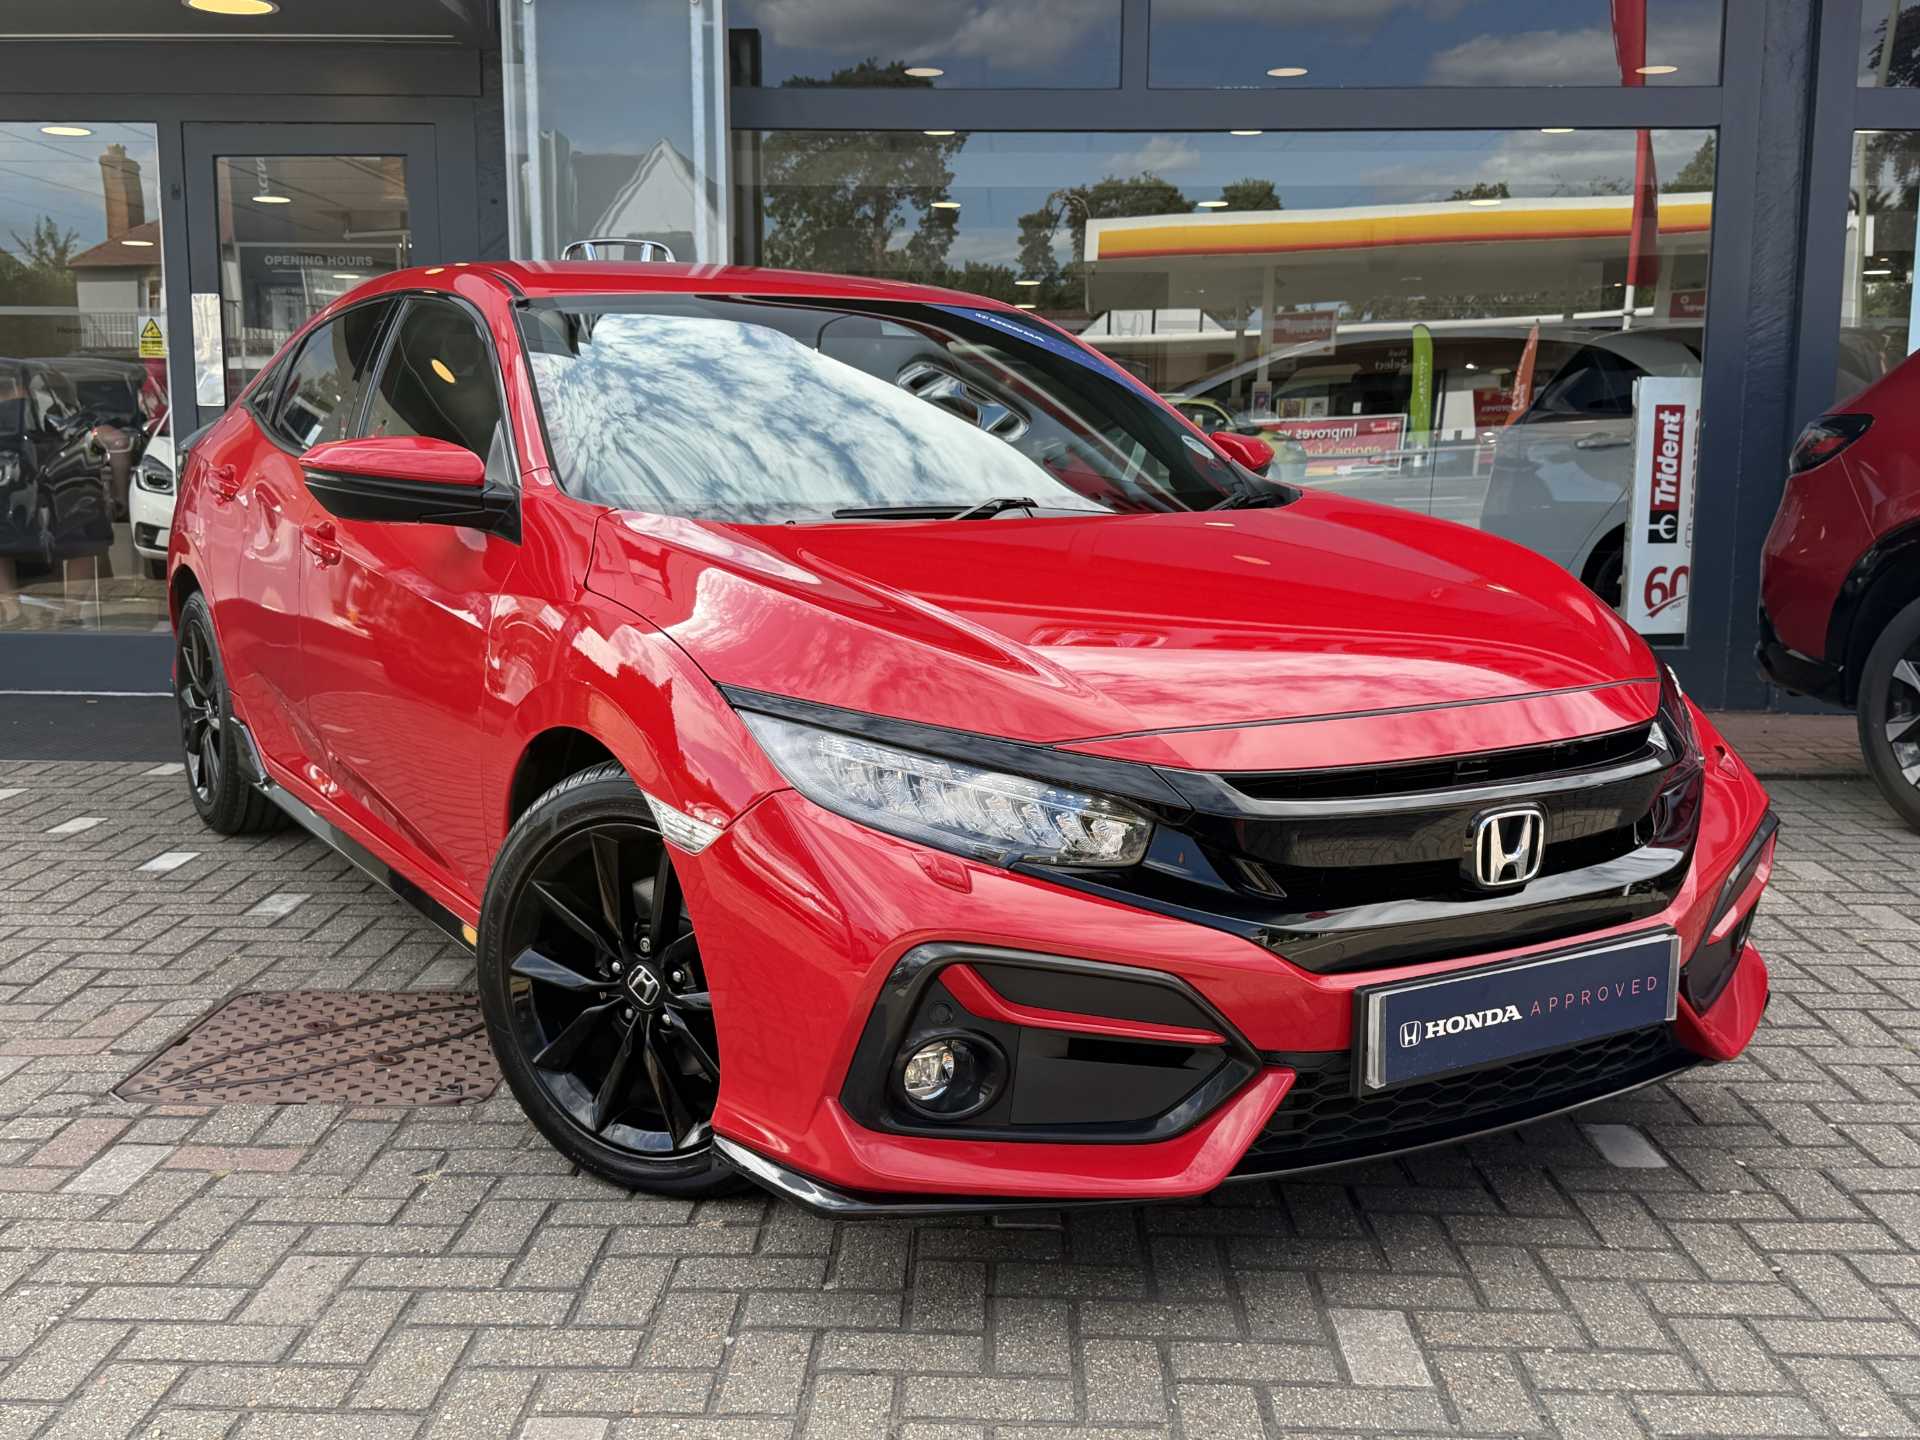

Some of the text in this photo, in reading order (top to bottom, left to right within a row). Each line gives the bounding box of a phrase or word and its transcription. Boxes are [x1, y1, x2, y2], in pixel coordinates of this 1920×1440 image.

[264, 255, 374, 267] OPENING HOURS
[1655, 410, 1682, 506] Trident
[1424, 1004, 1523, 1039] HONDA
[1530, 975, 1658, 1017] APPROVED
